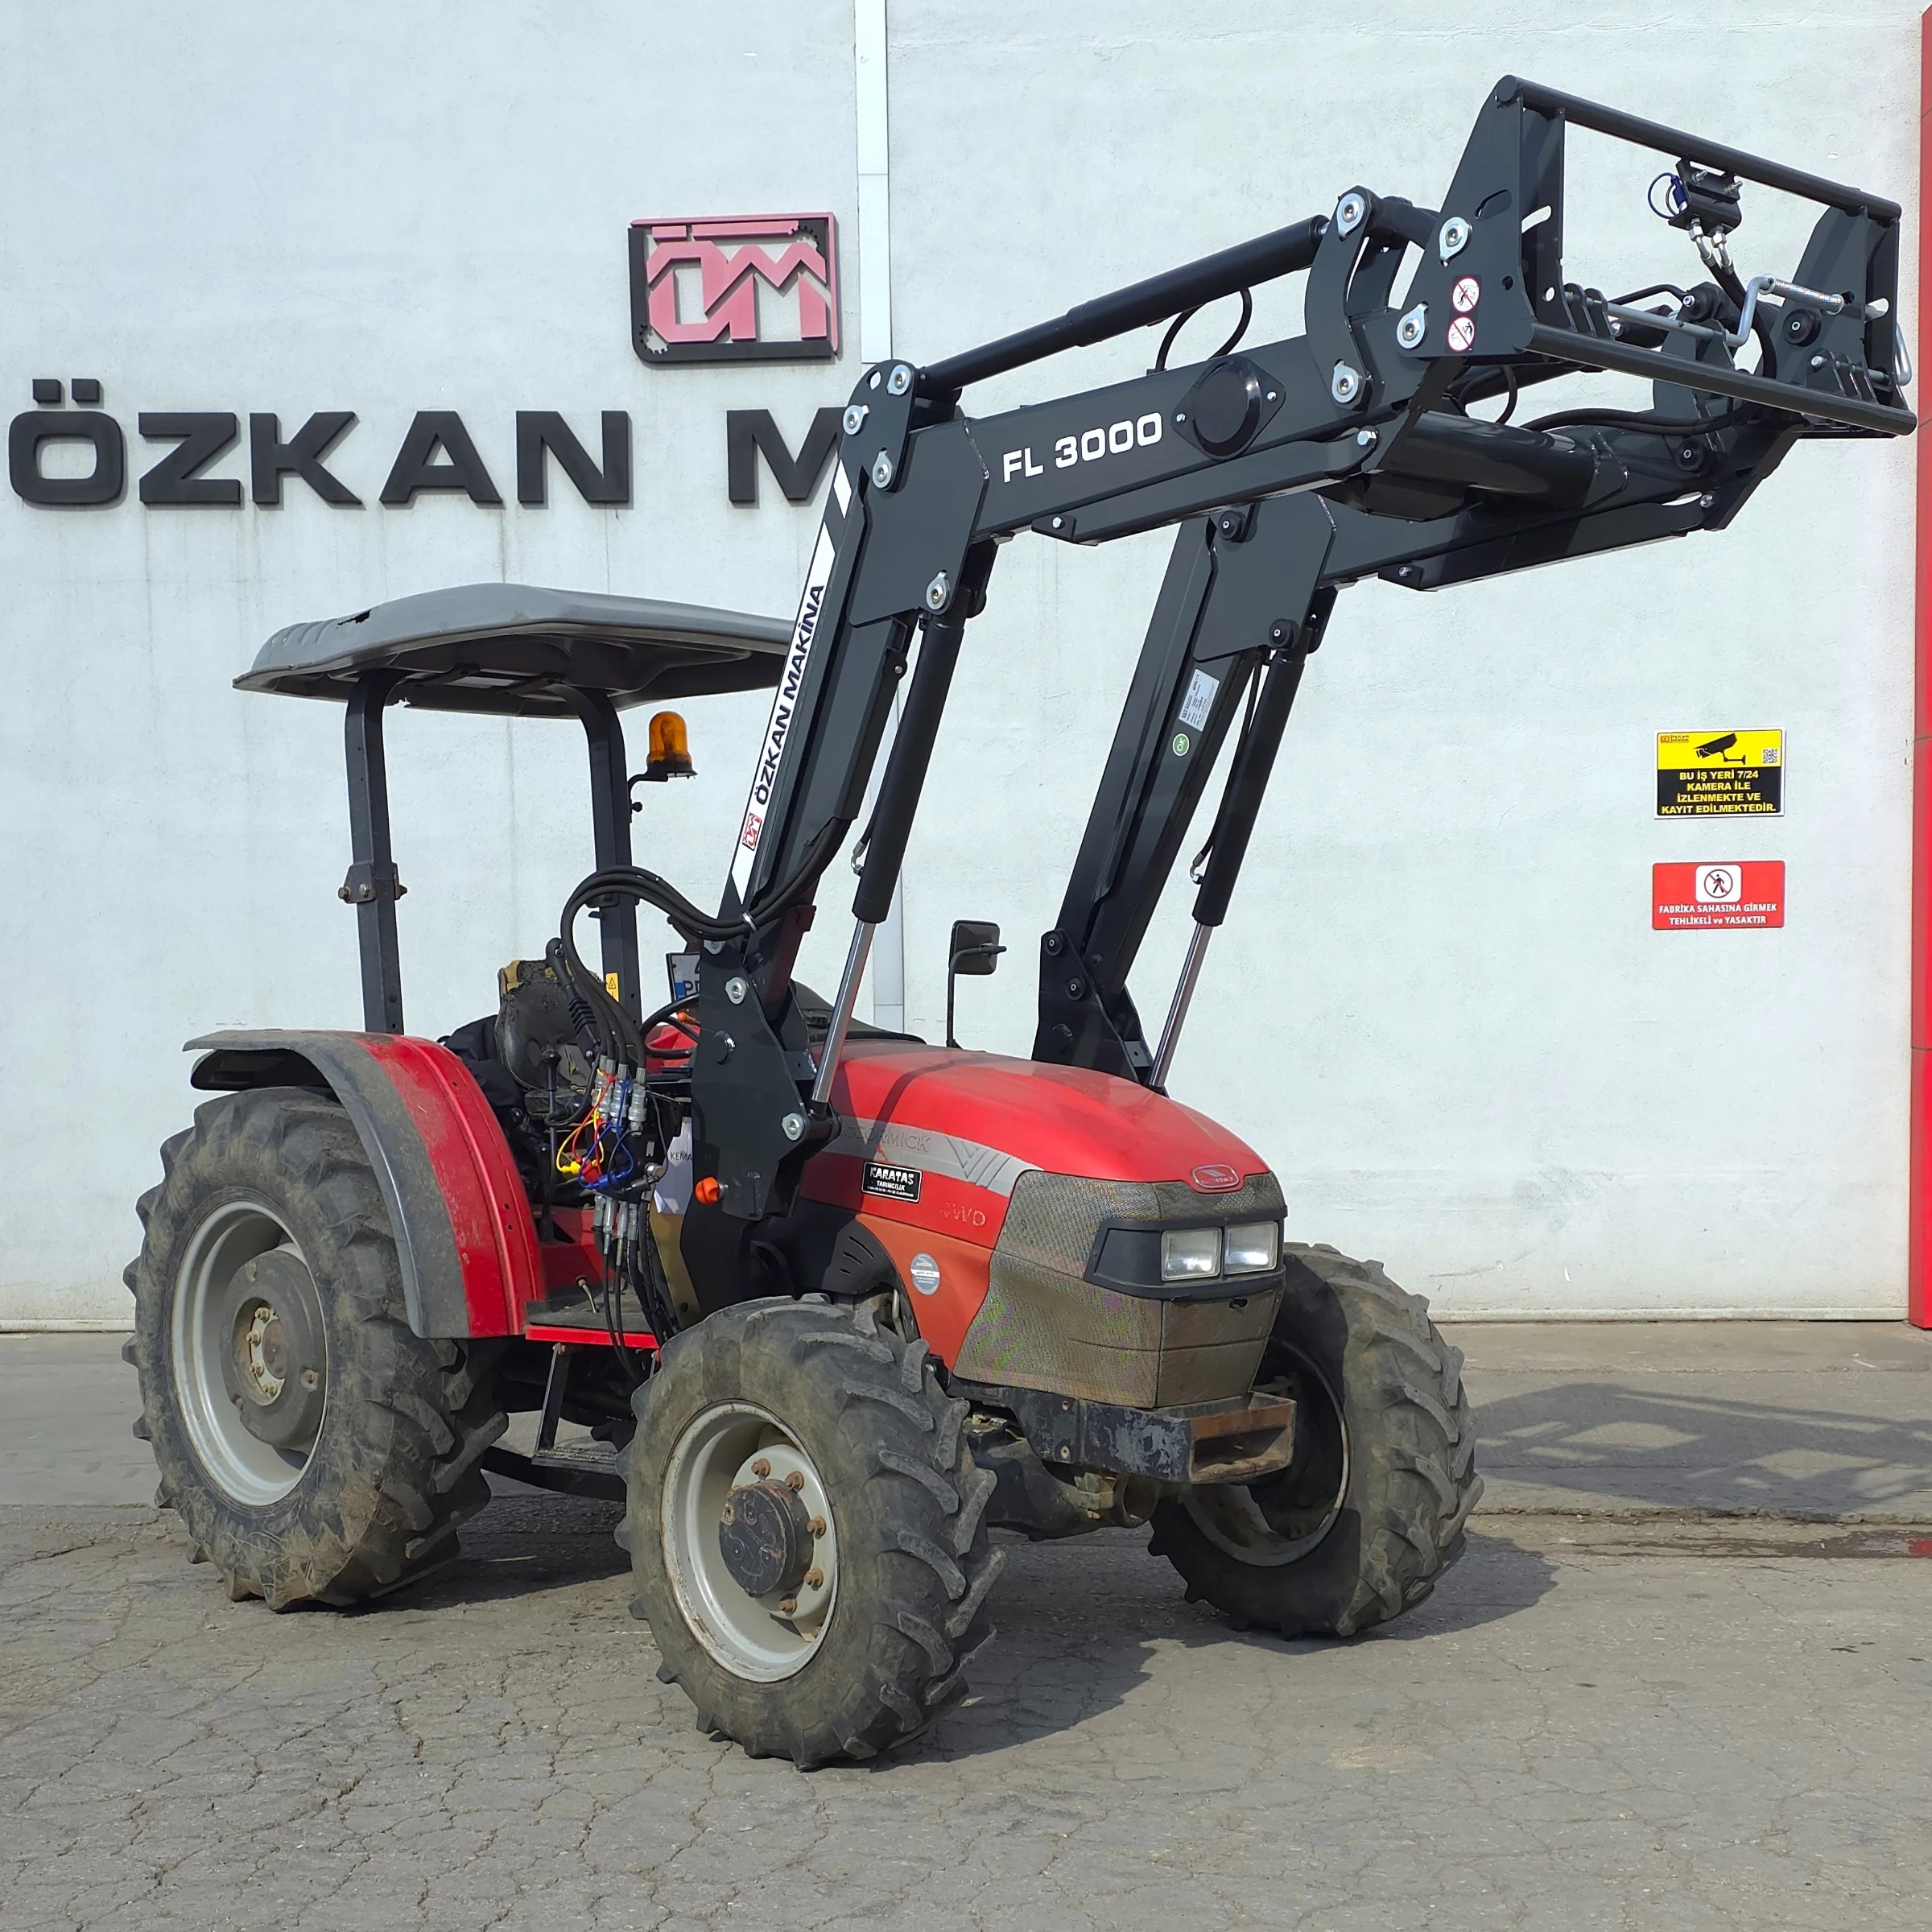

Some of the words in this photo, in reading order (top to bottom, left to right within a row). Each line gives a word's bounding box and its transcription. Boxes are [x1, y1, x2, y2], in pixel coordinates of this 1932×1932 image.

[8, 378, 632, 506] ÖZKAN
[1003, 447, 1044, 483] FL
[1055, 412, 1162, 469] 3000
[754, 704, 791, 806] ÖZKAN
[783, 584, 824, 701] MAKİNA
[1177, 737, 1187, 752] OK
[1679, 771, 1694, 781] BU
[1697, 770, 1707, 782] İŞ
[1711, 769, 1734, 779] YERİ
[1737, 770, 1759, 779] 7/24
[1686, 782, 1732, 791] KAMERA
[1734, 781, 1751, 791] İLE
[1677, 792, 1744, 803] İZLENMEKTE
[1746, 792, 1761, 801] VE
[1662, 805, 1693, 814] KAYIT
[1695, 802, 1776, 813] EDİLMEKTEDİR.
[1658, 903, 1695, 914] FABRİKA
[1697, 903, 1742, 913] SAHASINA
[1744, 902, 1777, 912] GİRMEK
[1669, 915, 1711, 925] TEHLİKELİ
[1725, 915, 1767, 924] YASAKTIR
